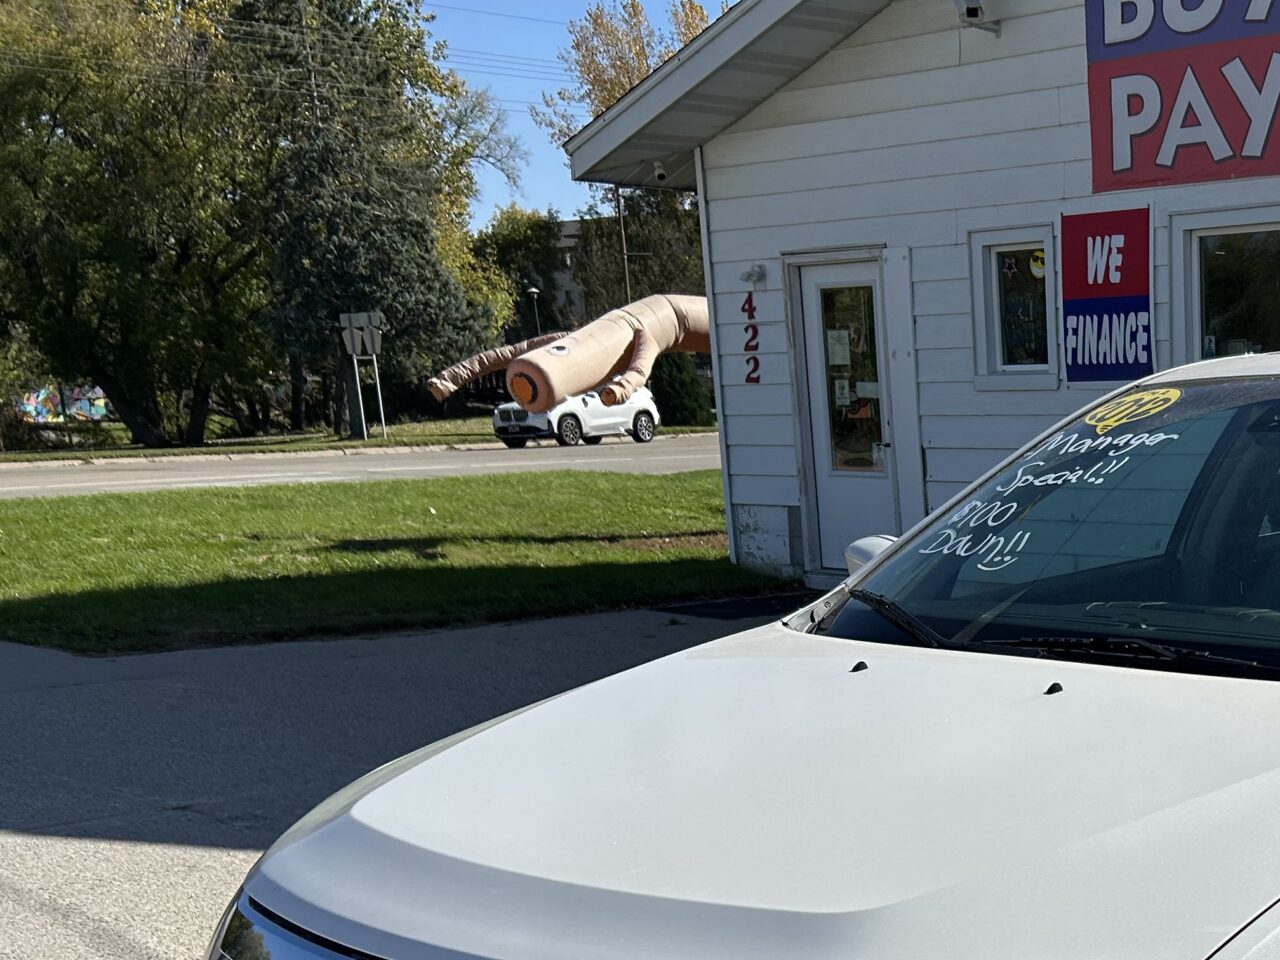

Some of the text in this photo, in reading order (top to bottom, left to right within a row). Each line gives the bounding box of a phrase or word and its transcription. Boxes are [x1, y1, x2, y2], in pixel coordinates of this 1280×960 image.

[1087, 234, 1125, 285] WE
[740, 291, 761, 384] 422
[1066, 311, 1149, 366] FINANCE
[1024, 432, 1180, 460] Manager
[947, 500, 1018, 528] $100
